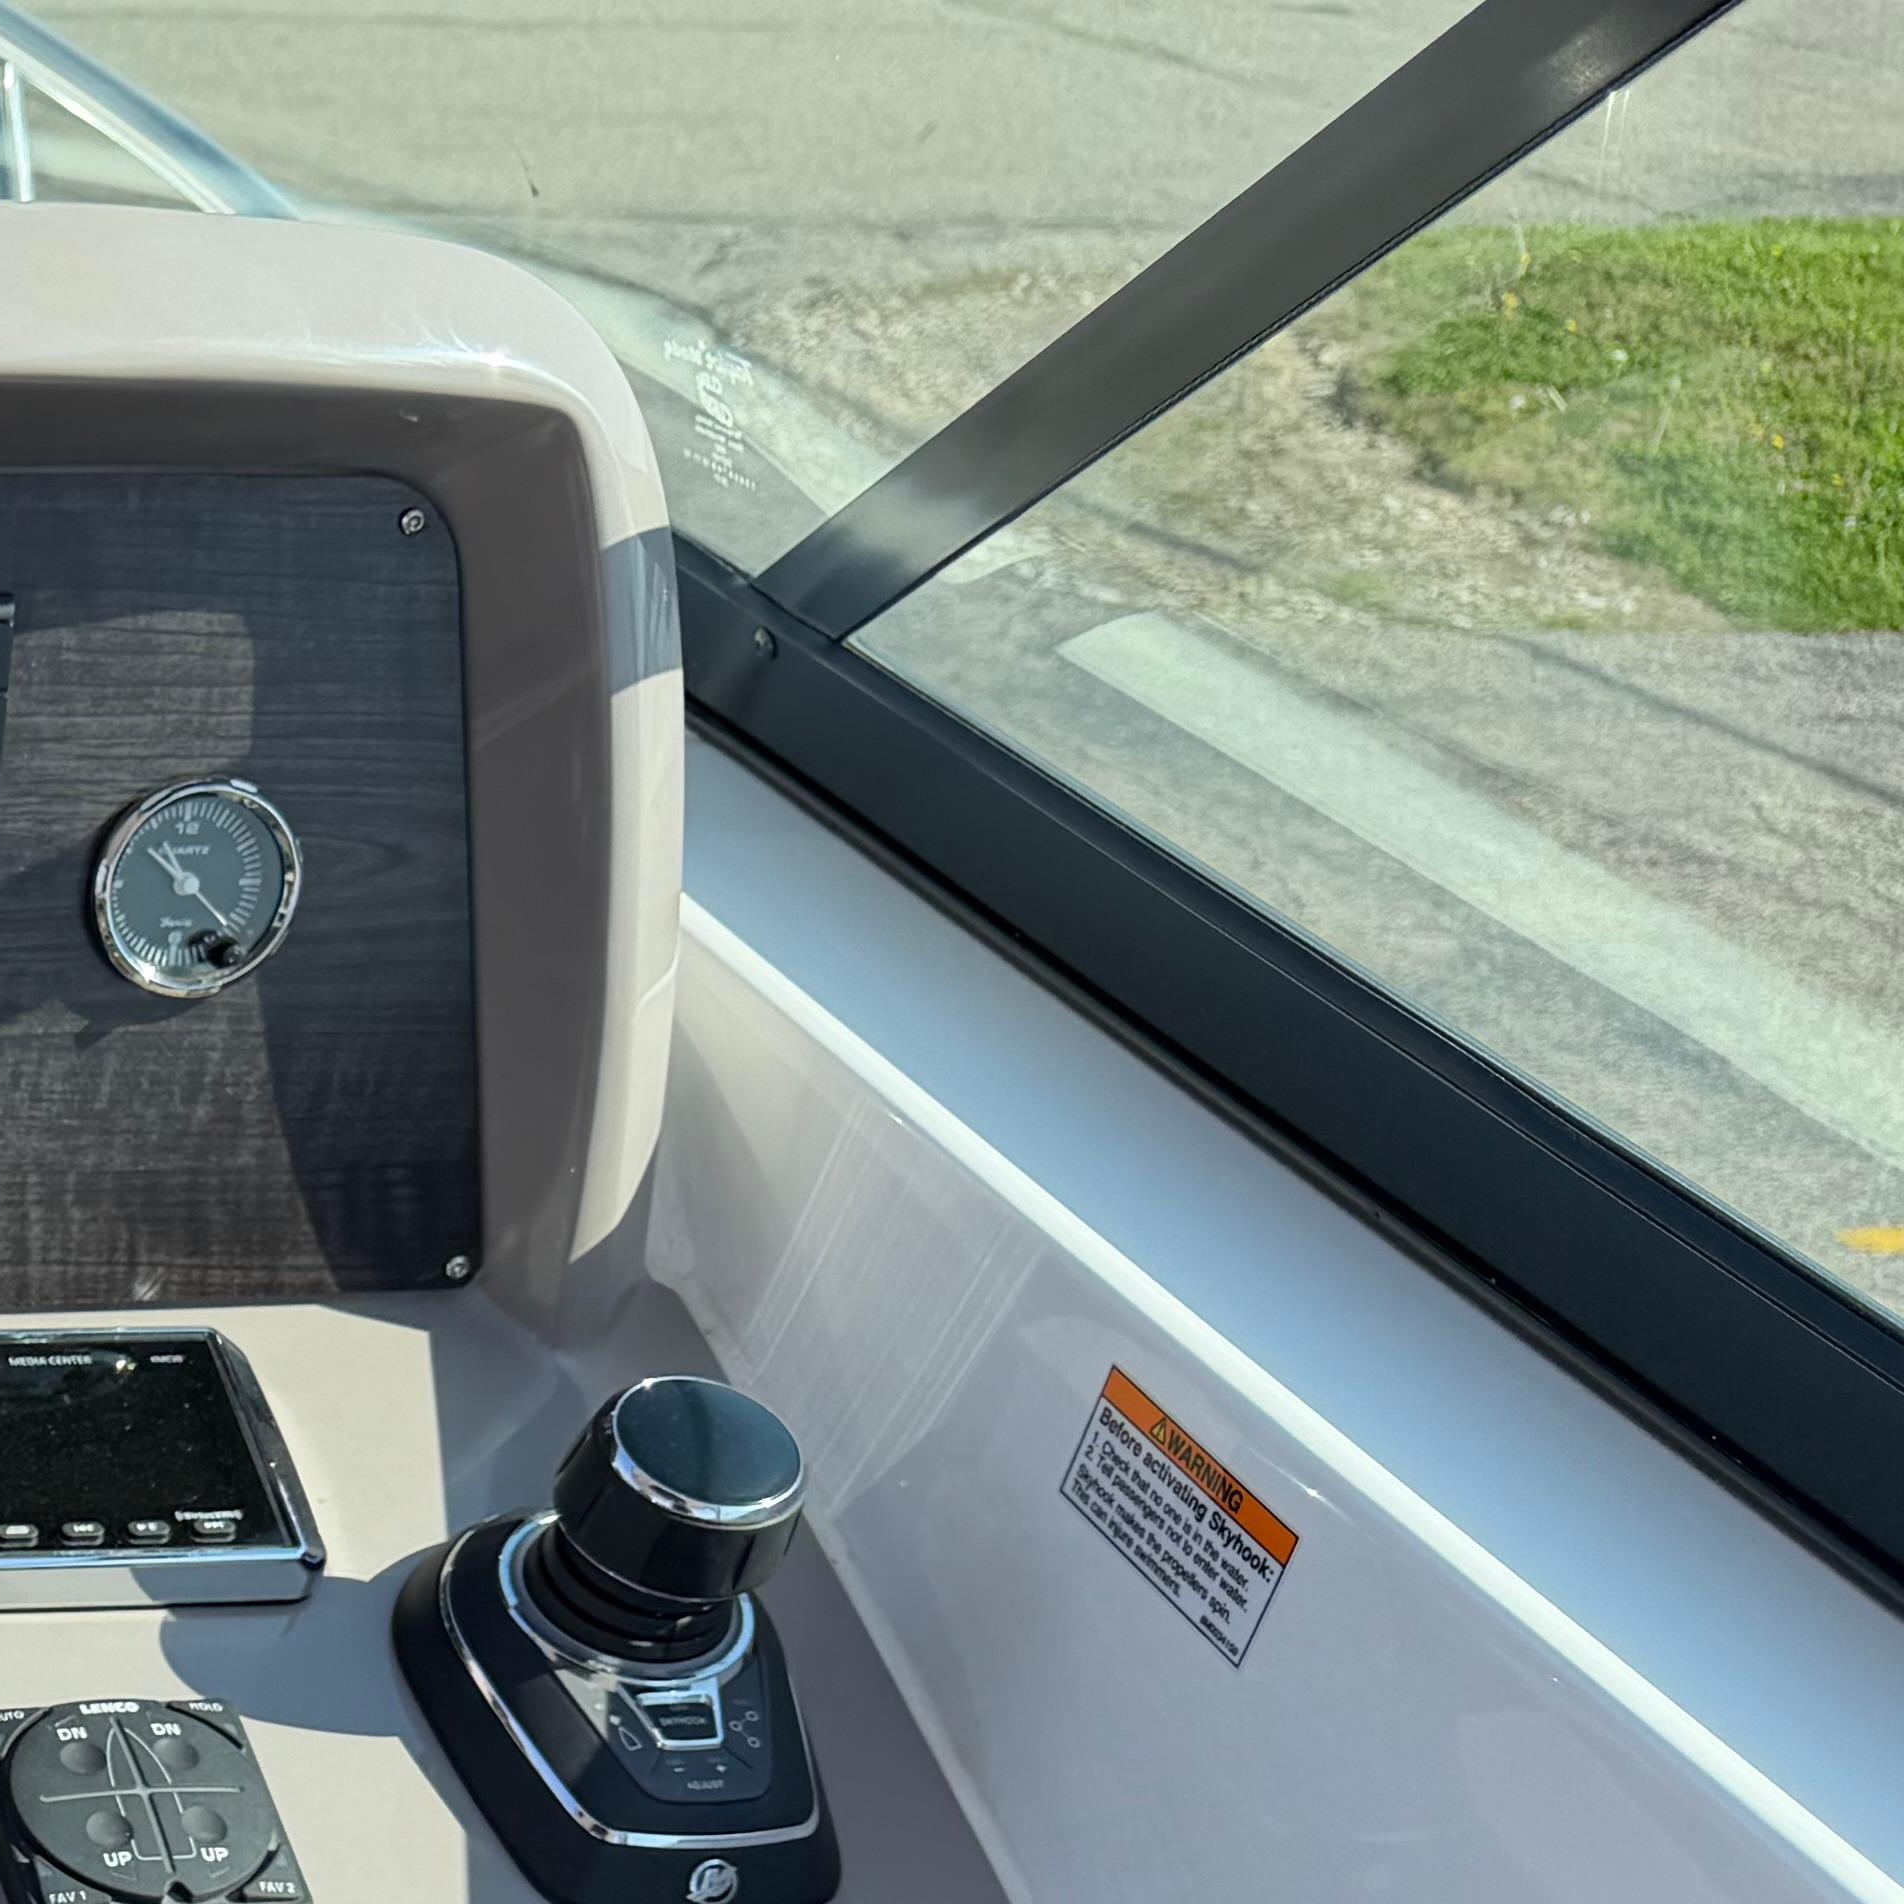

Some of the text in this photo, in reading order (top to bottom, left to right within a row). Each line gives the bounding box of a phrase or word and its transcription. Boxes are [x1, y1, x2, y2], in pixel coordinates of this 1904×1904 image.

[174, 822, 200, 834] 12
[8, 1355, 92, 1366] MEDIA CENTER
[1168, 1429, 1243, 1514] WARNING
[1099, 1406, 1274, 1583] Before activating Skyhook:
[1102, 1441, 1130, 1475] Check
[1131, 1470, 1150, 1494] that
[1149, 1490, 1163, 1506] no
[1163, 1503, 1182, 1525] one
[1182, 1518, 1193, 1536] is
[1192, 1526, 1203, 1545] in
[1203, 1539, 1220, 1562] the
[1220, 1557, 1249, 1592] water.
[1096, 1453, 1114, 1479] Tell
[1112, 1475, 1165, 1530] passengers
[1165, 1525, 1183, 1547] not
[1182, 1539, 1193, 1556] to
[1193, 1552, 1220, 1582] enter
[1219, 1577, 1248, 1613] water.
[1076, 1463, 1116, 1508] Skyhook
[1115, 1503, 1146, 1539] makes
[1146, 1532, 1162, 1555] the
[1161, 1550, 1209, 1601] propellers
[1208, 1596, 1230, 1625] spin.
[1090, 1501, 1107, 1524] can
[1108, 1517, 1134, 1549] injure
[1134, 1545, 1180, 1598] swimmers.
[79, 1701, 140, 1715] LENCO
[57, 1722, 181, 1742] DN DN
[103, 1847, 229, 1868] UP UP
[49, 1891, 86, 1904] FAV 1
[259, 1882, 283, 1894] FAV
